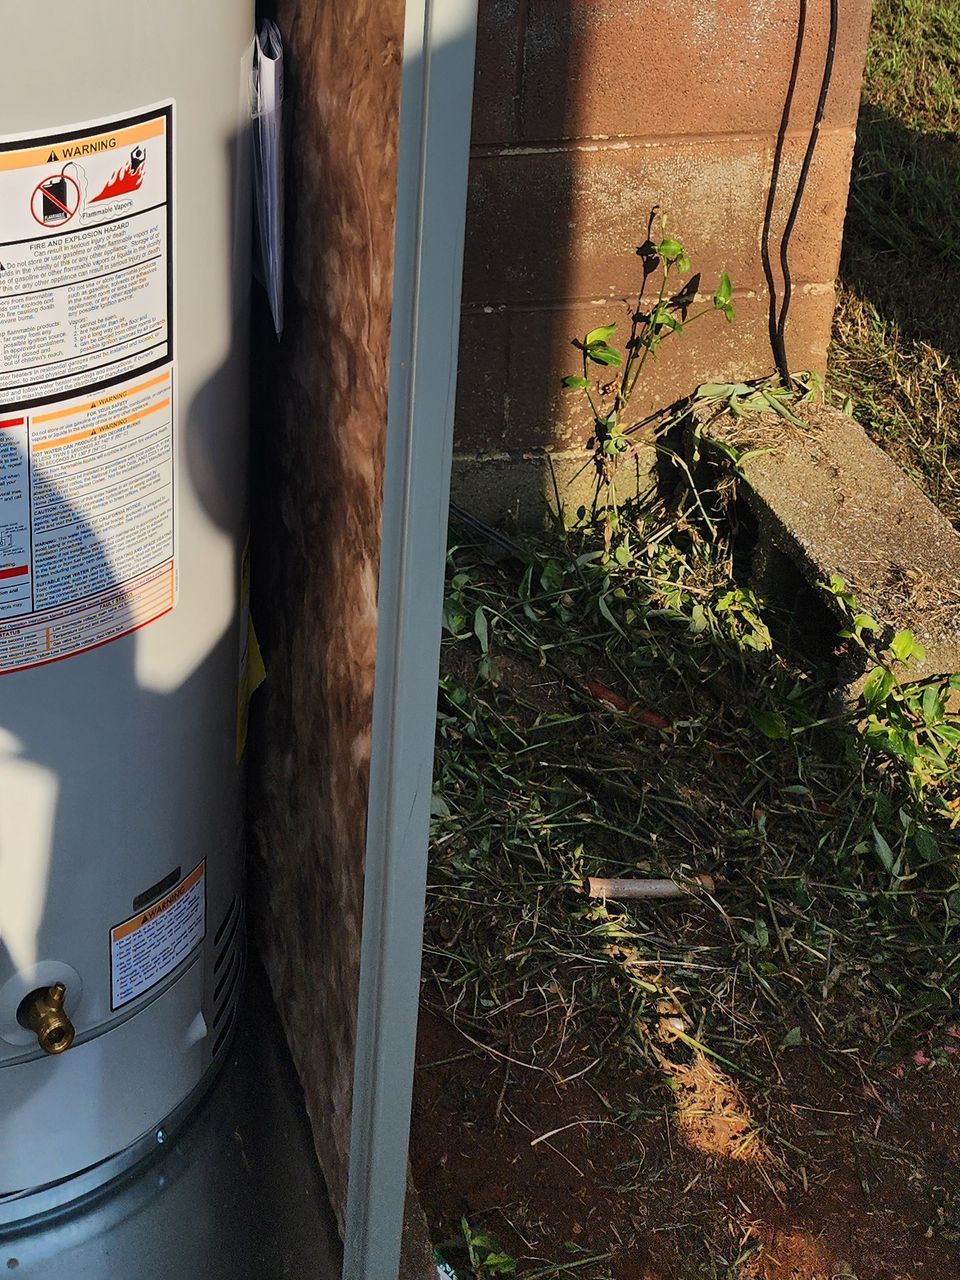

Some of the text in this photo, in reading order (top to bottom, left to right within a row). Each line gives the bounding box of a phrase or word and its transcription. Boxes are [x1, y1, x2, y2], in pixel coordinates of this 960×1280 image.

[62, 138, 117, 158] WARNING
[82, 205, 113, 219] Flammable
[114, 201, 132, 213] Vapors
[29, 222, 130, 251] FIRE AND EXPLOSION HAZARD
[6, 261, 14, 269] Do
[16, 260, 27, 268] not
[28, 256, 43, 266] store
[63, 247, 85, 259] gasoline
[93, 241, 107, 251] other
[47, 246, 63, 255] result
[70, 240, 89, 249] serious
[98, 391, 127, 406] WARNING
[99, 418, 127, 433] WARNING
[148, 885, 185, 919] WARNING
